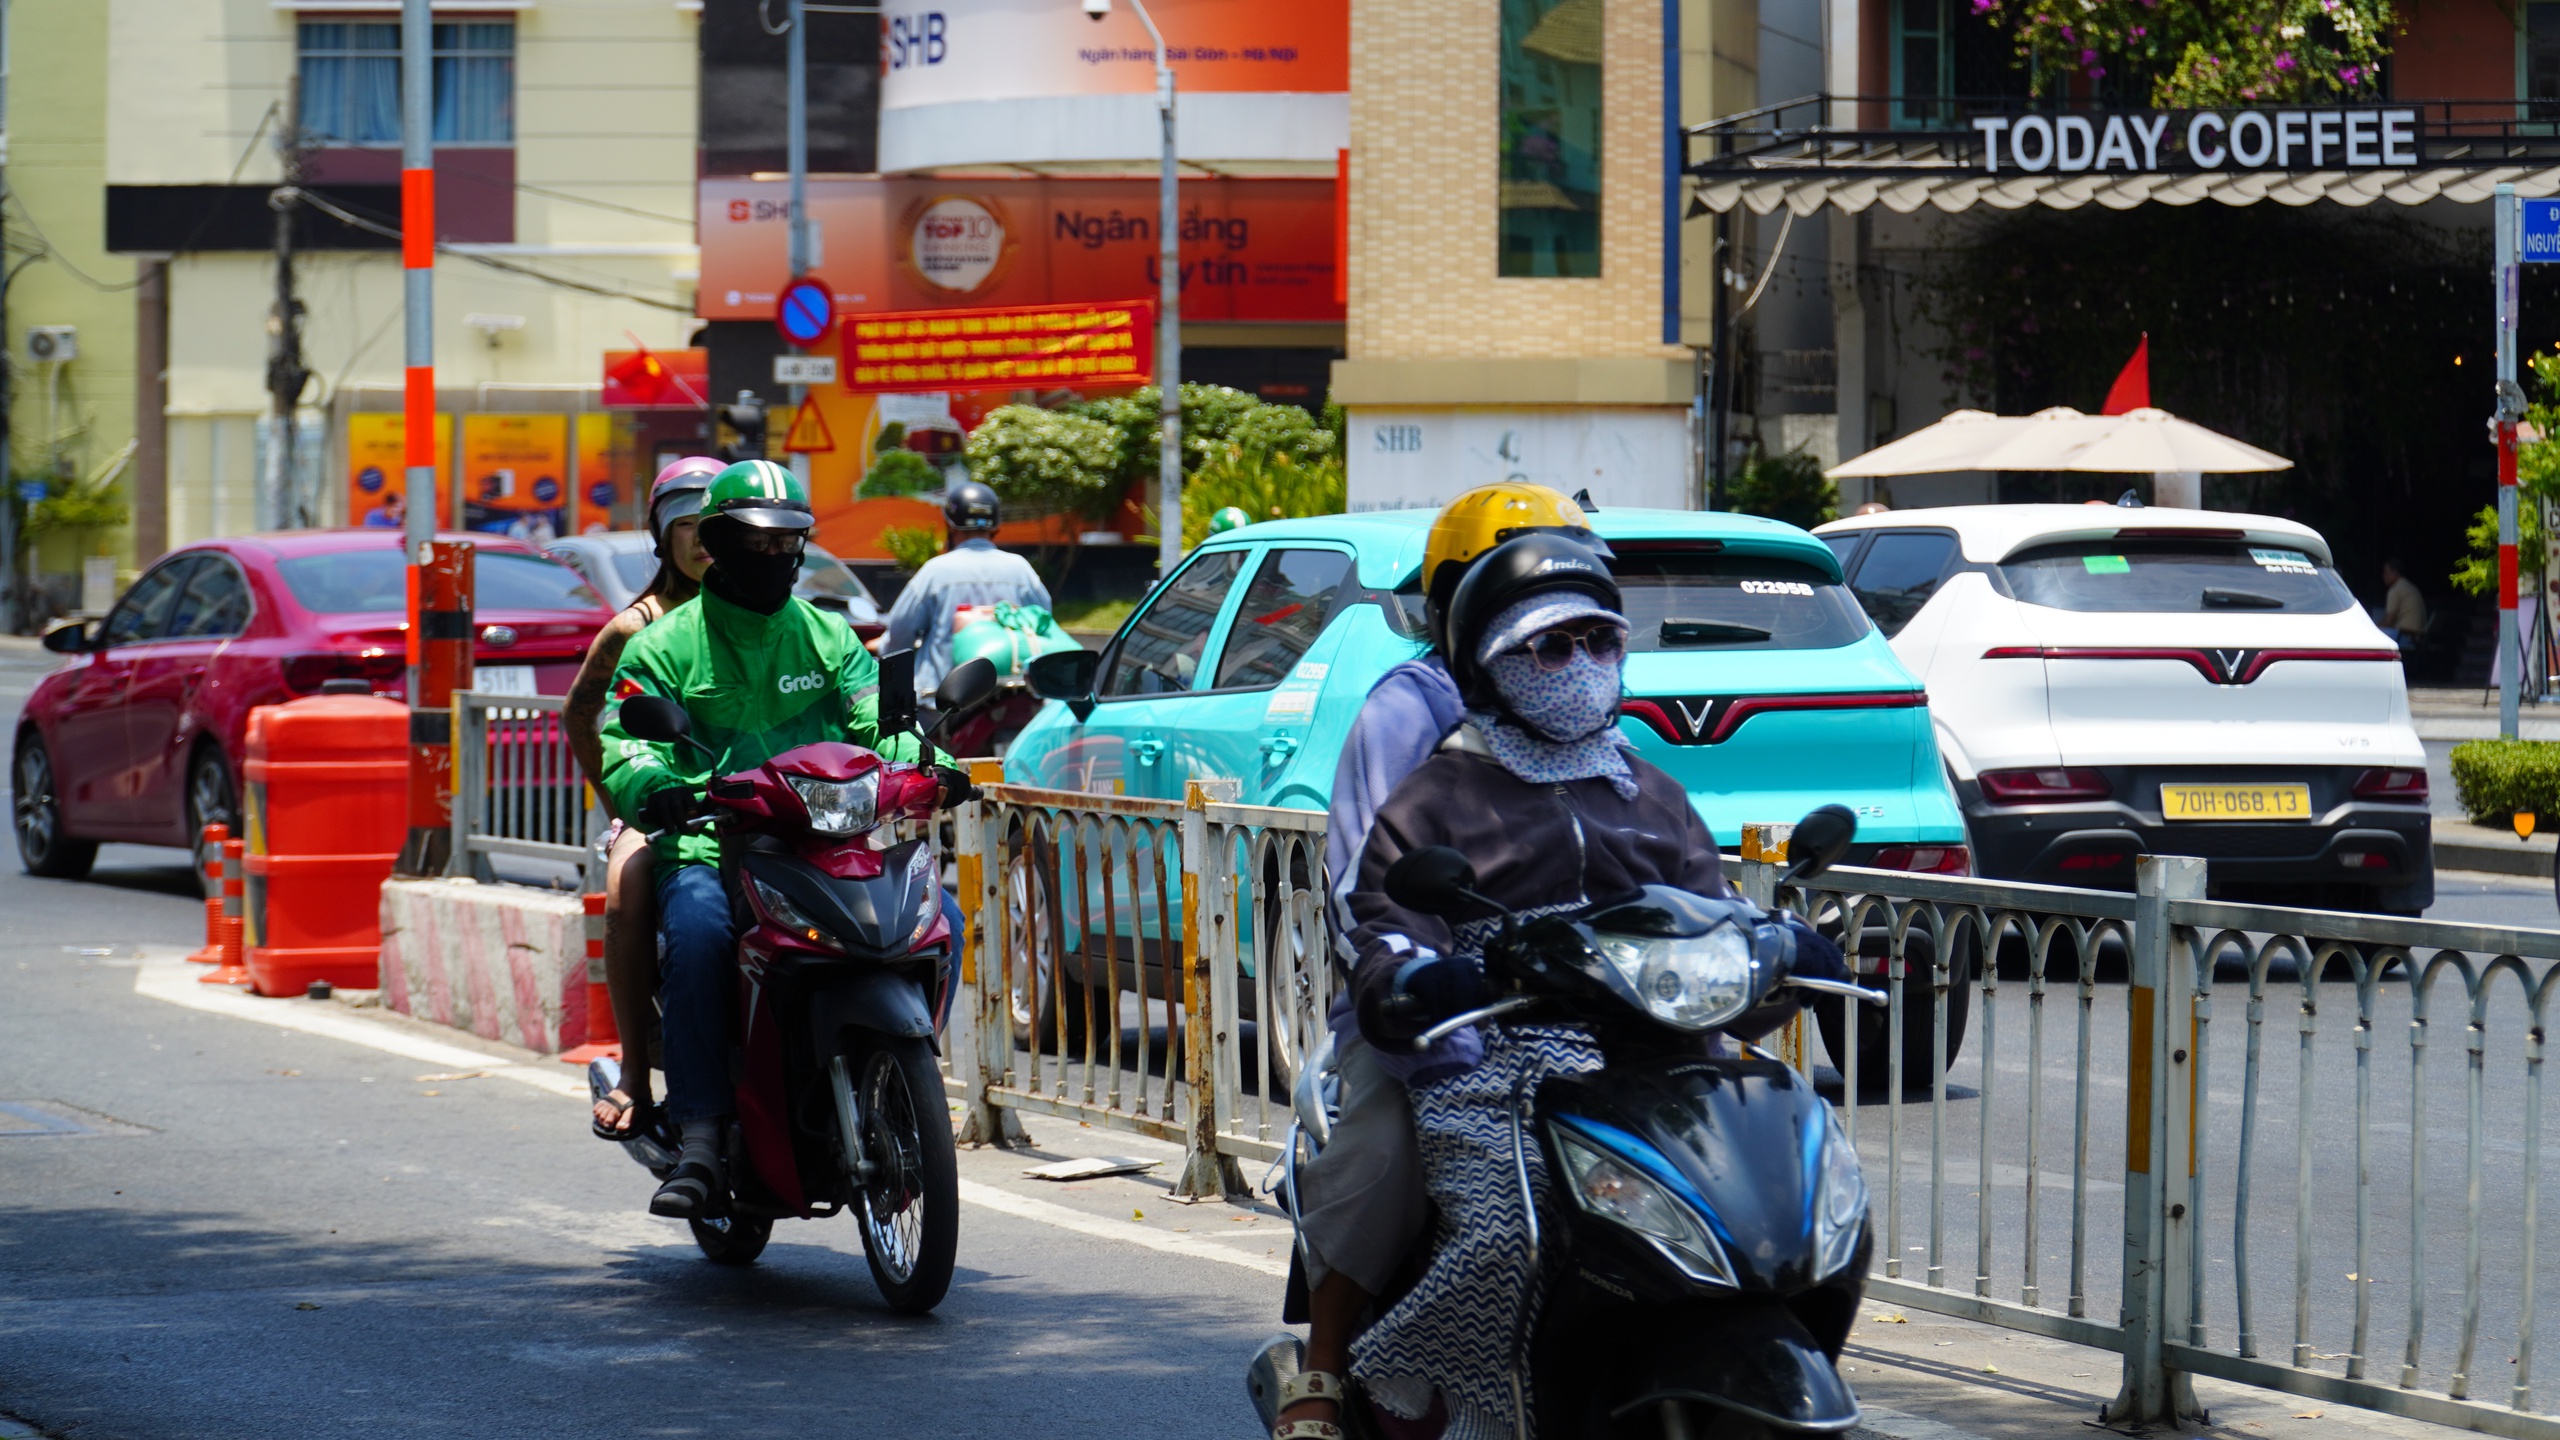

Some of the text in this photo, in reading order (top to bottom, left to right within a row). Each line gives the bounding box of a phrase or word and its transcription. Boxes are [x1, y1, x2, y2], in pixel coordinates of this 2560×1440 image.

[892, 13, 946, 69] SHB
[1972, 110, 2418, 174] TODAY COFFEE
[756, 201, 803, 220] SH
[924, 216, 993, 241] TOP 10
[1056, 208, 1150, 251] Ngân
[1374, 425, 1422, 453] SHB
[1534, 558, 1593, 574] Andes
[1740, 580, 1815, 596] 02295B
[778, 670, 825, 694] Grab
[2175, 791, 2297, 813] 70H-068.13
[833, 848, 866, 858] HONDA
[1667, 1064, 1721, 1076] HONDA
[1579, 1266, 1636, 1301] HONDA
